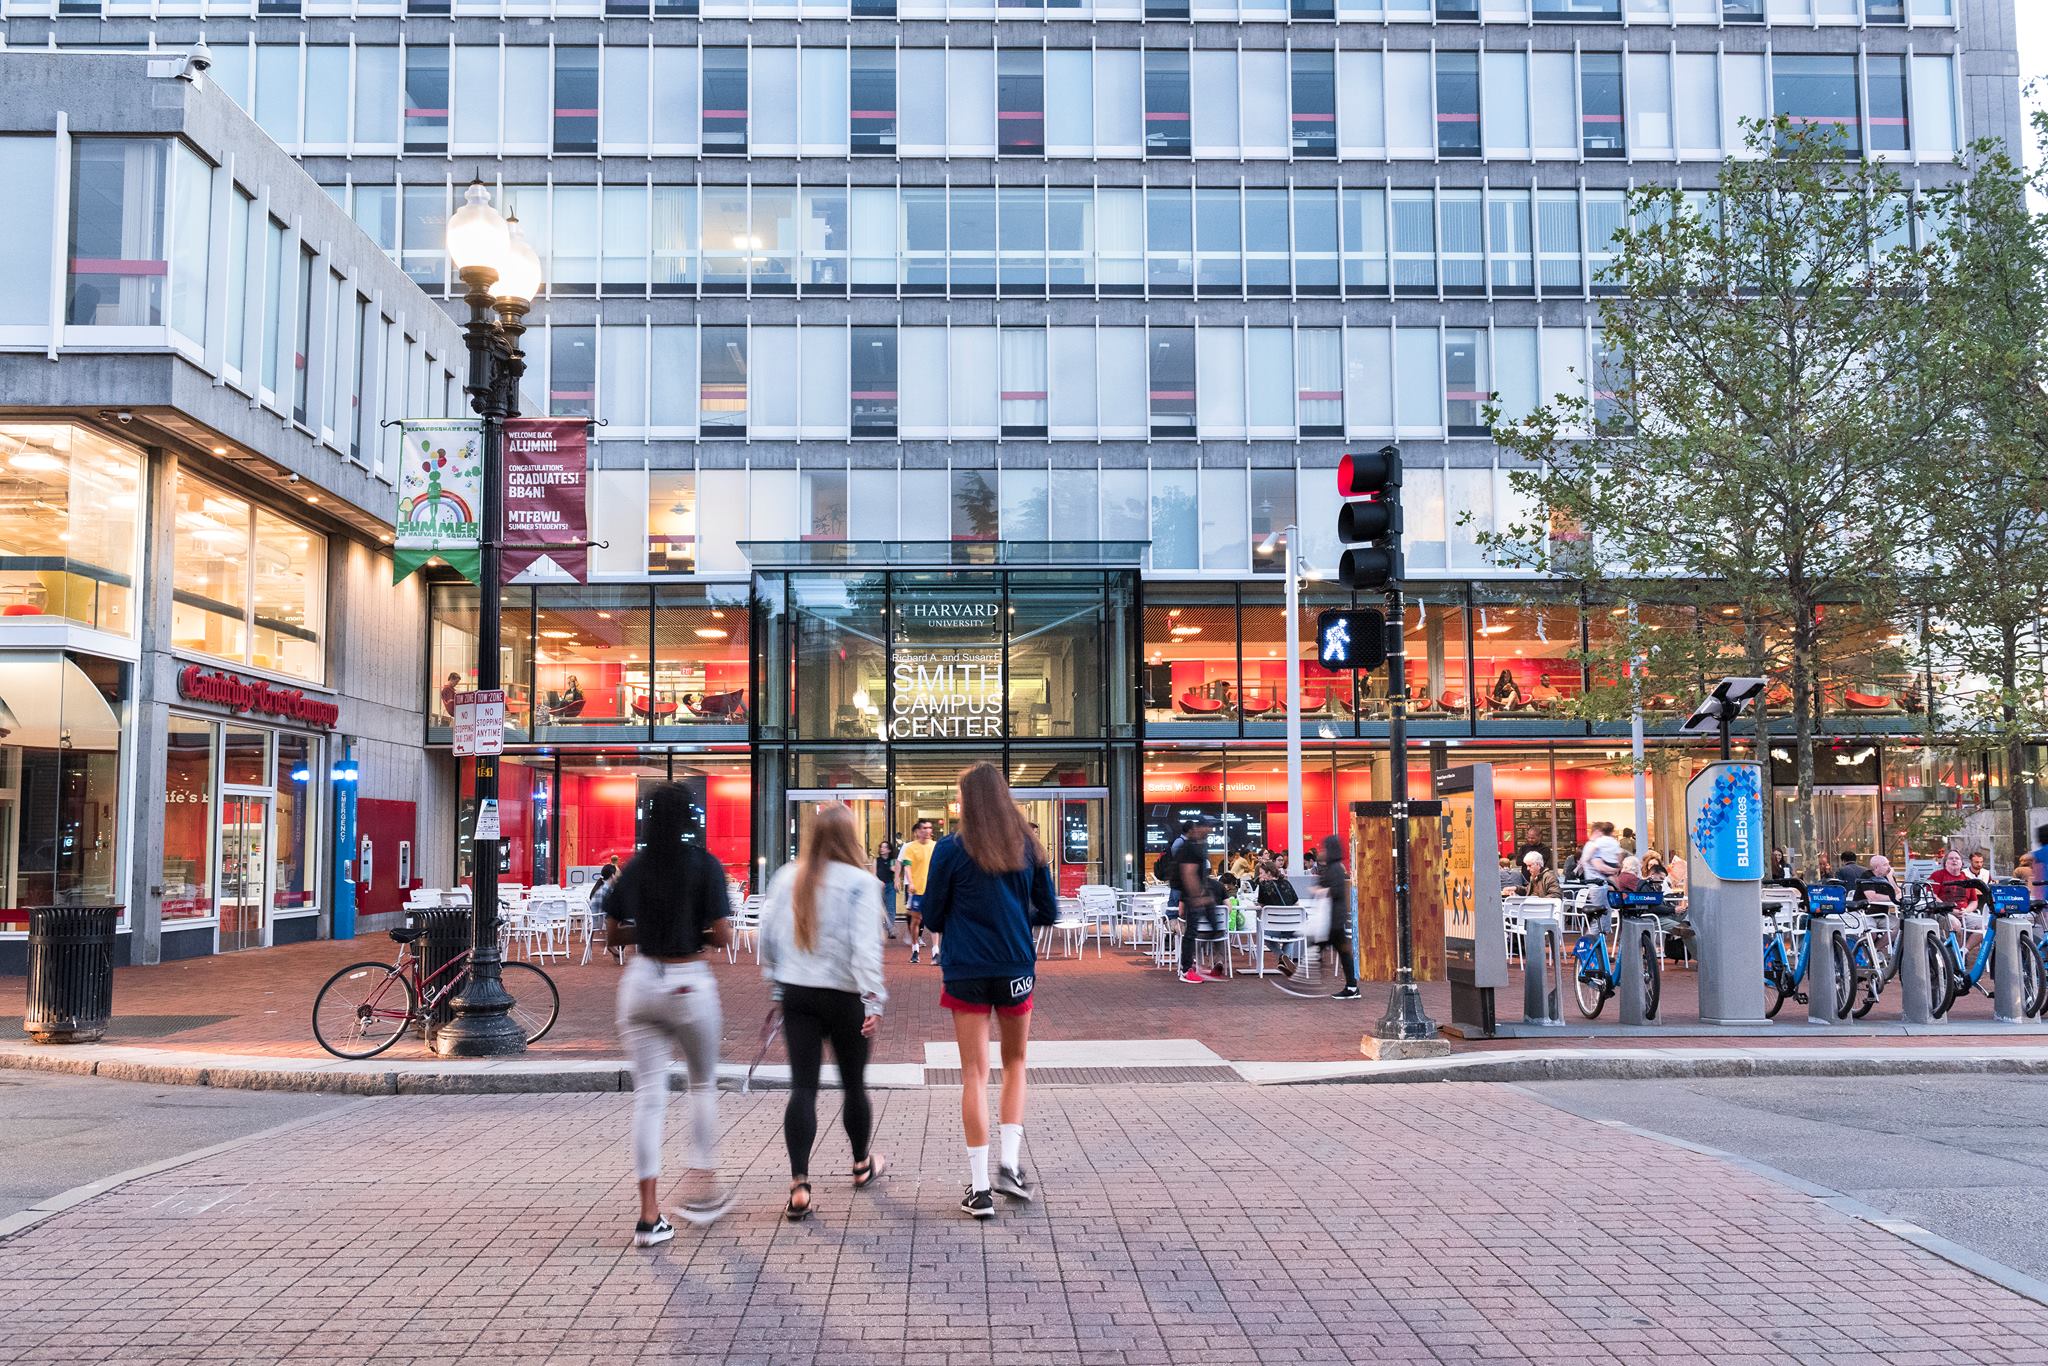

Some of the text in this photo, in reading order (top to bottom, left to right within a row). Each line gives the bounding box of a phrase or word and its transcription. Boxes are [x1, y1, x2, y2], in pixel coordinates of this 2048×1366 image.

[509, 440, 557, 452] ALUMNI!
[508, 473, 579, 485] GRADUATES!
[508, 486, 545, 498] BB4N!
[508, 511, 560, 522] MTFBWU
[398, 521, 478, 533] SUMMER
[914, 604, 999, 617] HARVARD
[892, 654, 927, 662] Richard
[942, 654, 960, 662] and
[962, 654, 992, 662] Susan
[892, 664, 1003, 691] SMITH
[183, 665, 339, 729] Cambridge Trust Company
[892, 694, 1003, 714] CAMPUS
[461, 711, 468, 720] NO
[484, 708, 494, 716] NO
[477, 717, 502, 727] STOPPING
[892, 716, 1003, 737] CENTER
[455, 724, 474, 734] STOPPING
[477, 728, 501, 737] ANYTIME
[1175, 783, 1216, 792] Welcome
[1219, 782, 1256, 791] Pavilion
[1735, 795, 1749, 867] BLUEbikes
